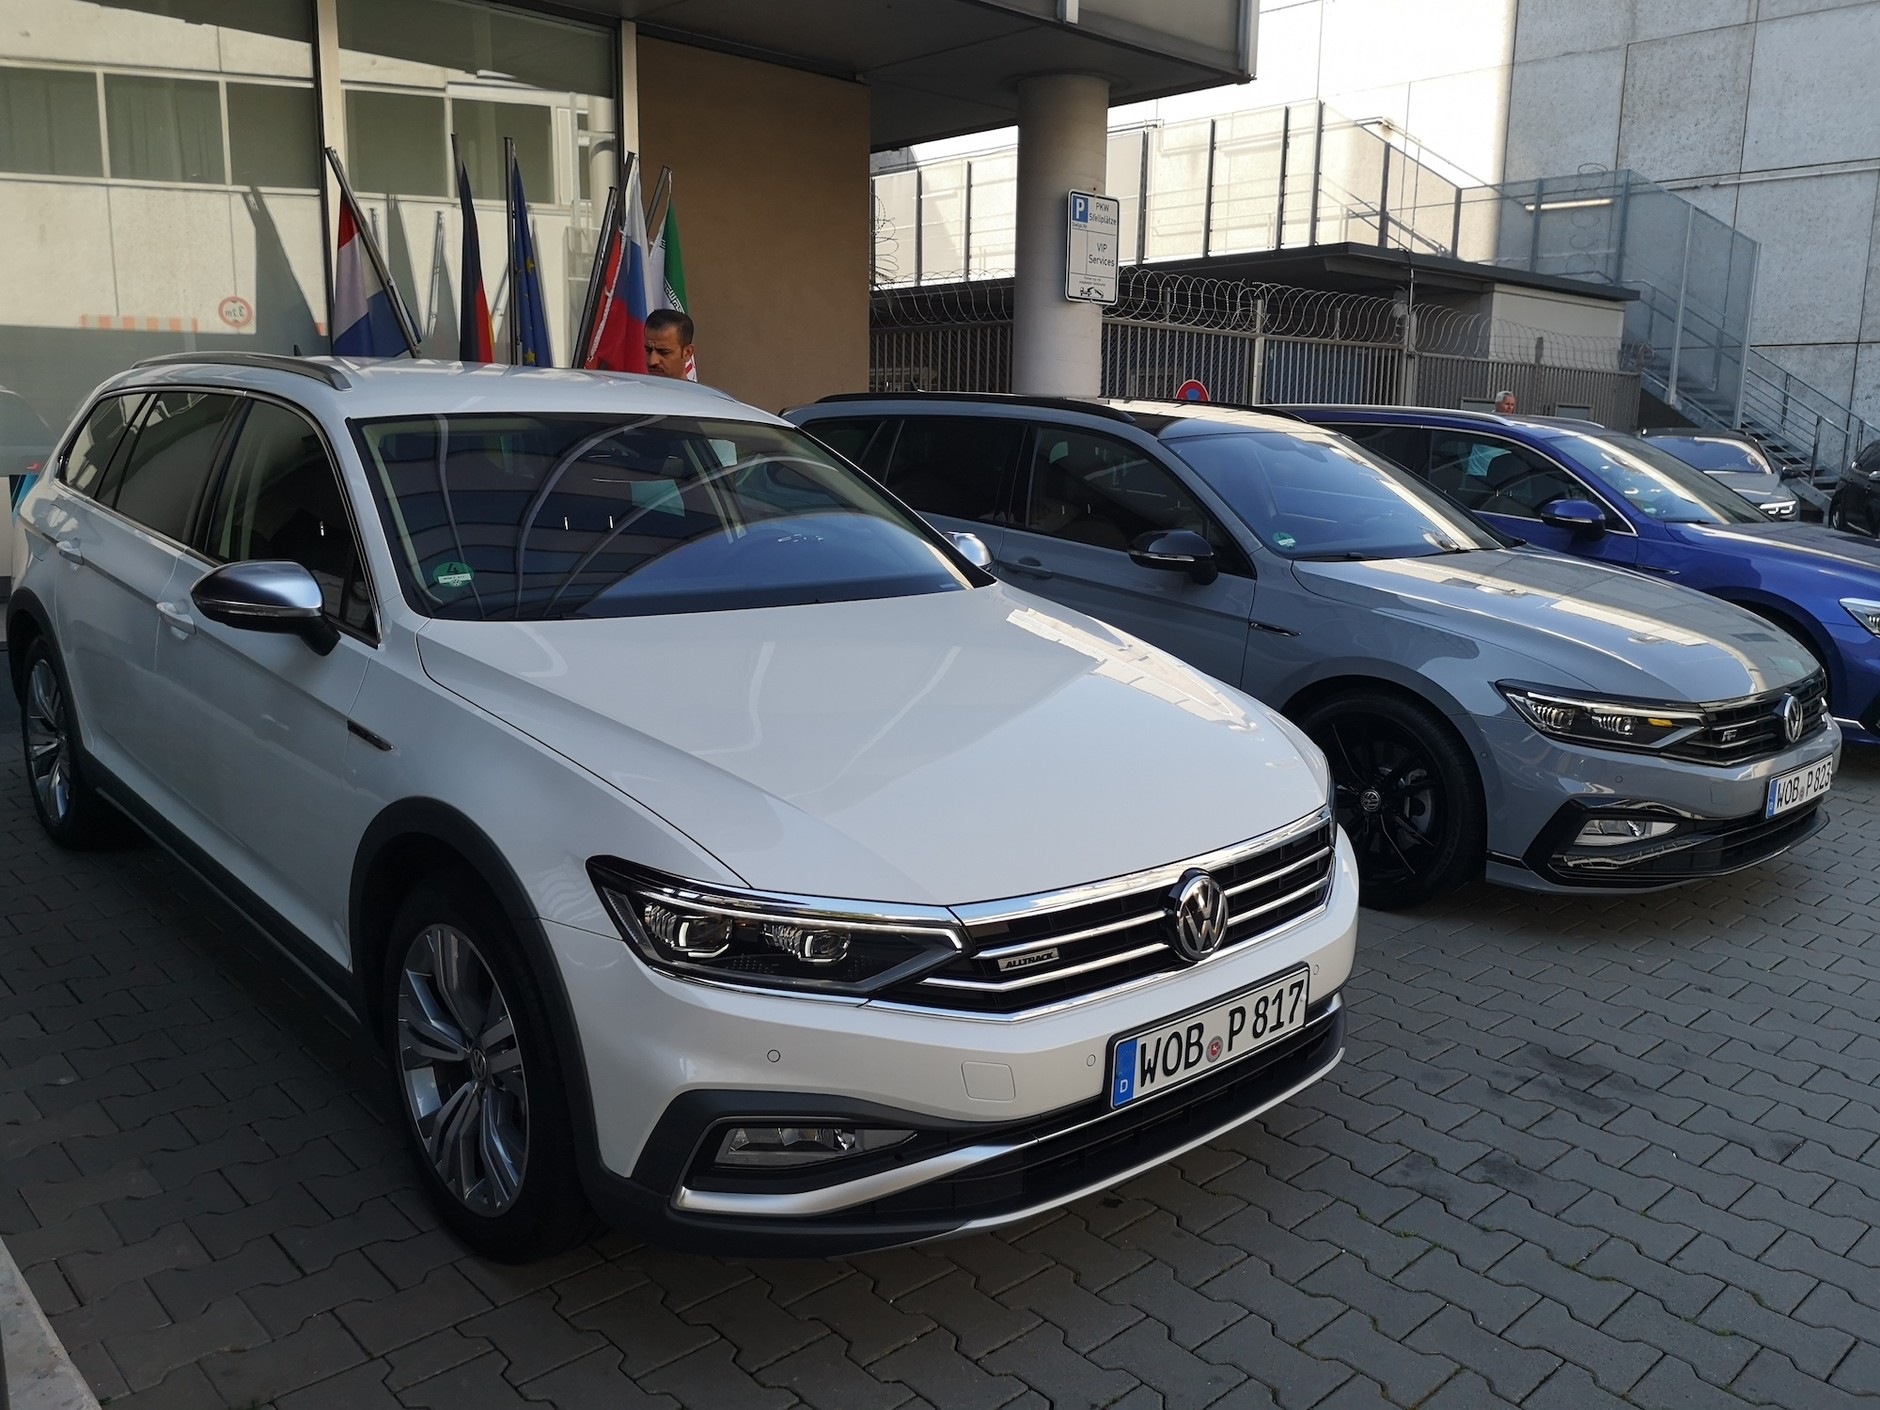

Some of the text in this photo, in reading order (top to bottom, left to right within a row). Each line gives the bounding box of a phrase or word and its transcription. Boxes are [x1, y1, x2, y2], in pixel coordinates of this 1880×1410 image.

[1076, 198, 1085, 219] P
[1096, 203, 1109, 212] PKW
[1097, 243, 1107, 252] VIP
[1089, 255, 1114, 266] Services
[1776, 761, 1832, 809] WOB P 823
[1004, 951, 1054, 969] ALLTRACK
[1139, 978, 1305, 1088] WOB P 817
[1119, 1078, 1129, 1094] D
